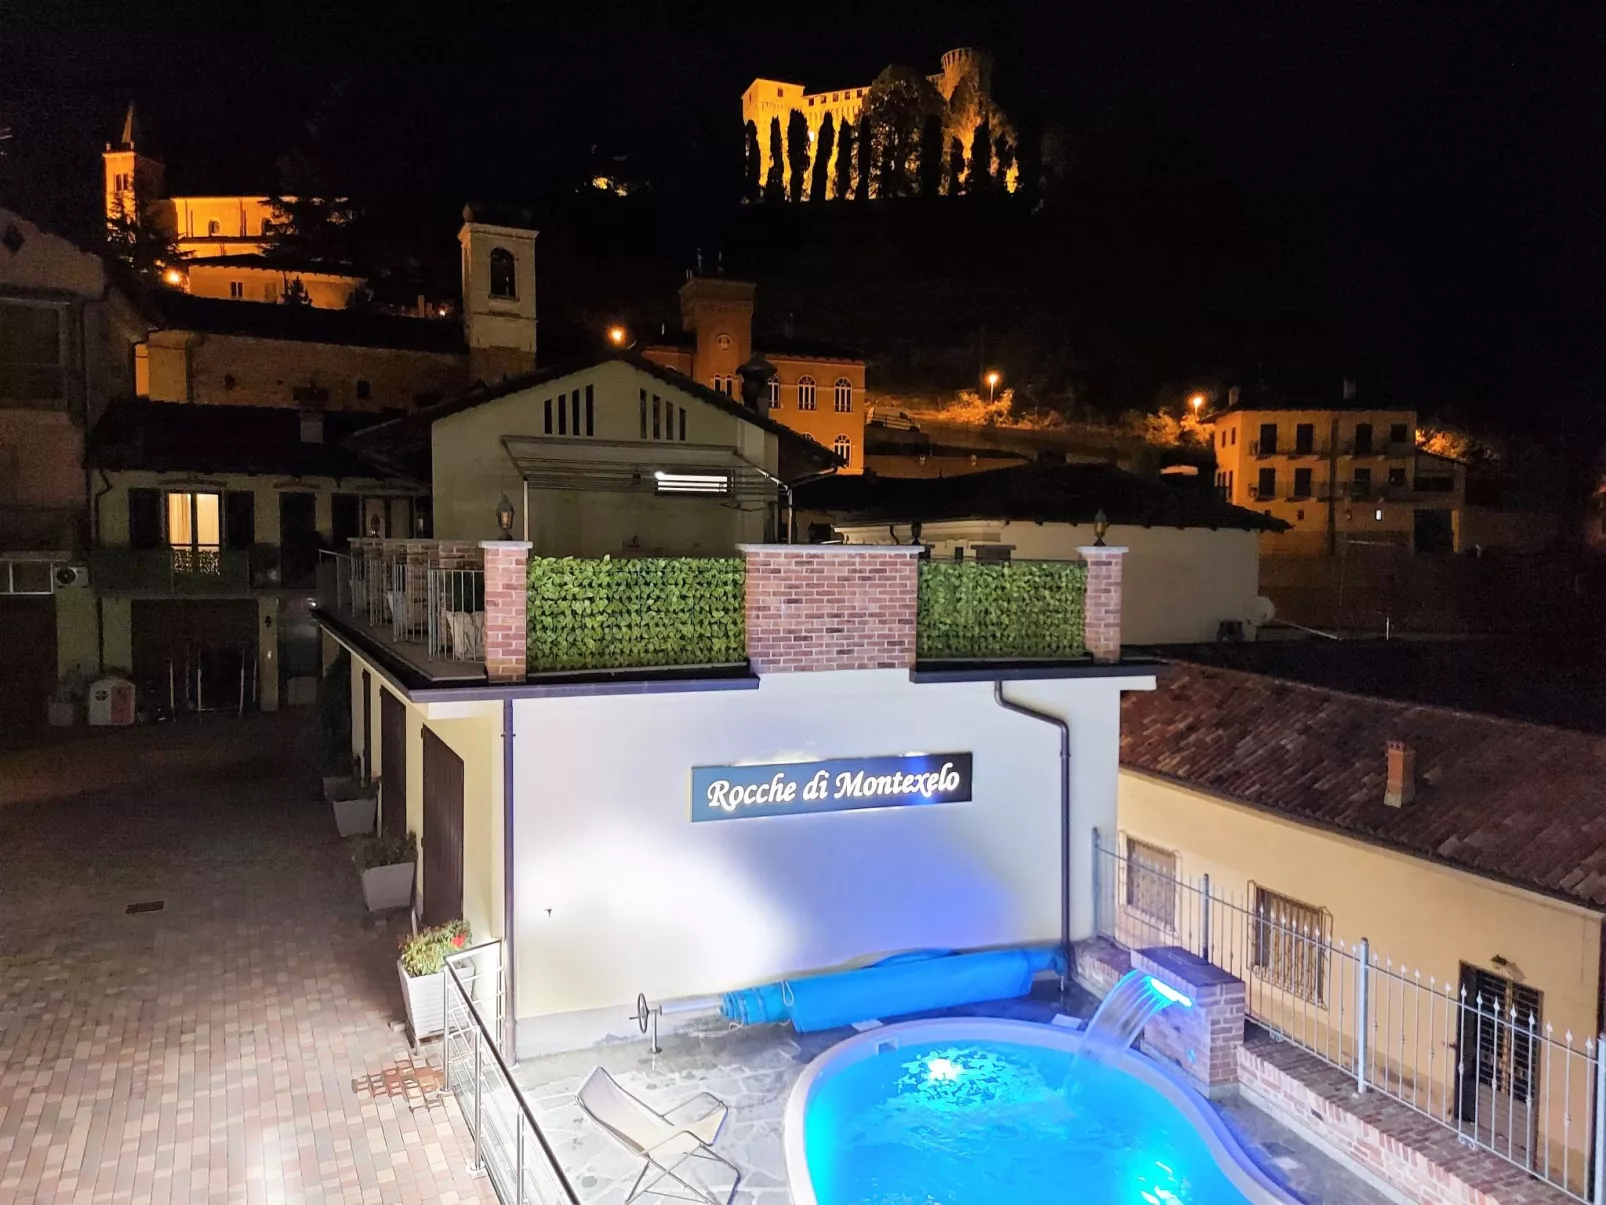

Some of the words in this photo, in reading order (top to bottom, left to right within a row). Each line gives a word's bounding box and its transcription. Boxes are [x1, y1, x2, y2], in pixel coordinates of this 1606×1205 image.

[707, 772, 796, 812] Rocche
[802, 769, 829, 801] di
[834, 762, 960, 798] Montexelo
